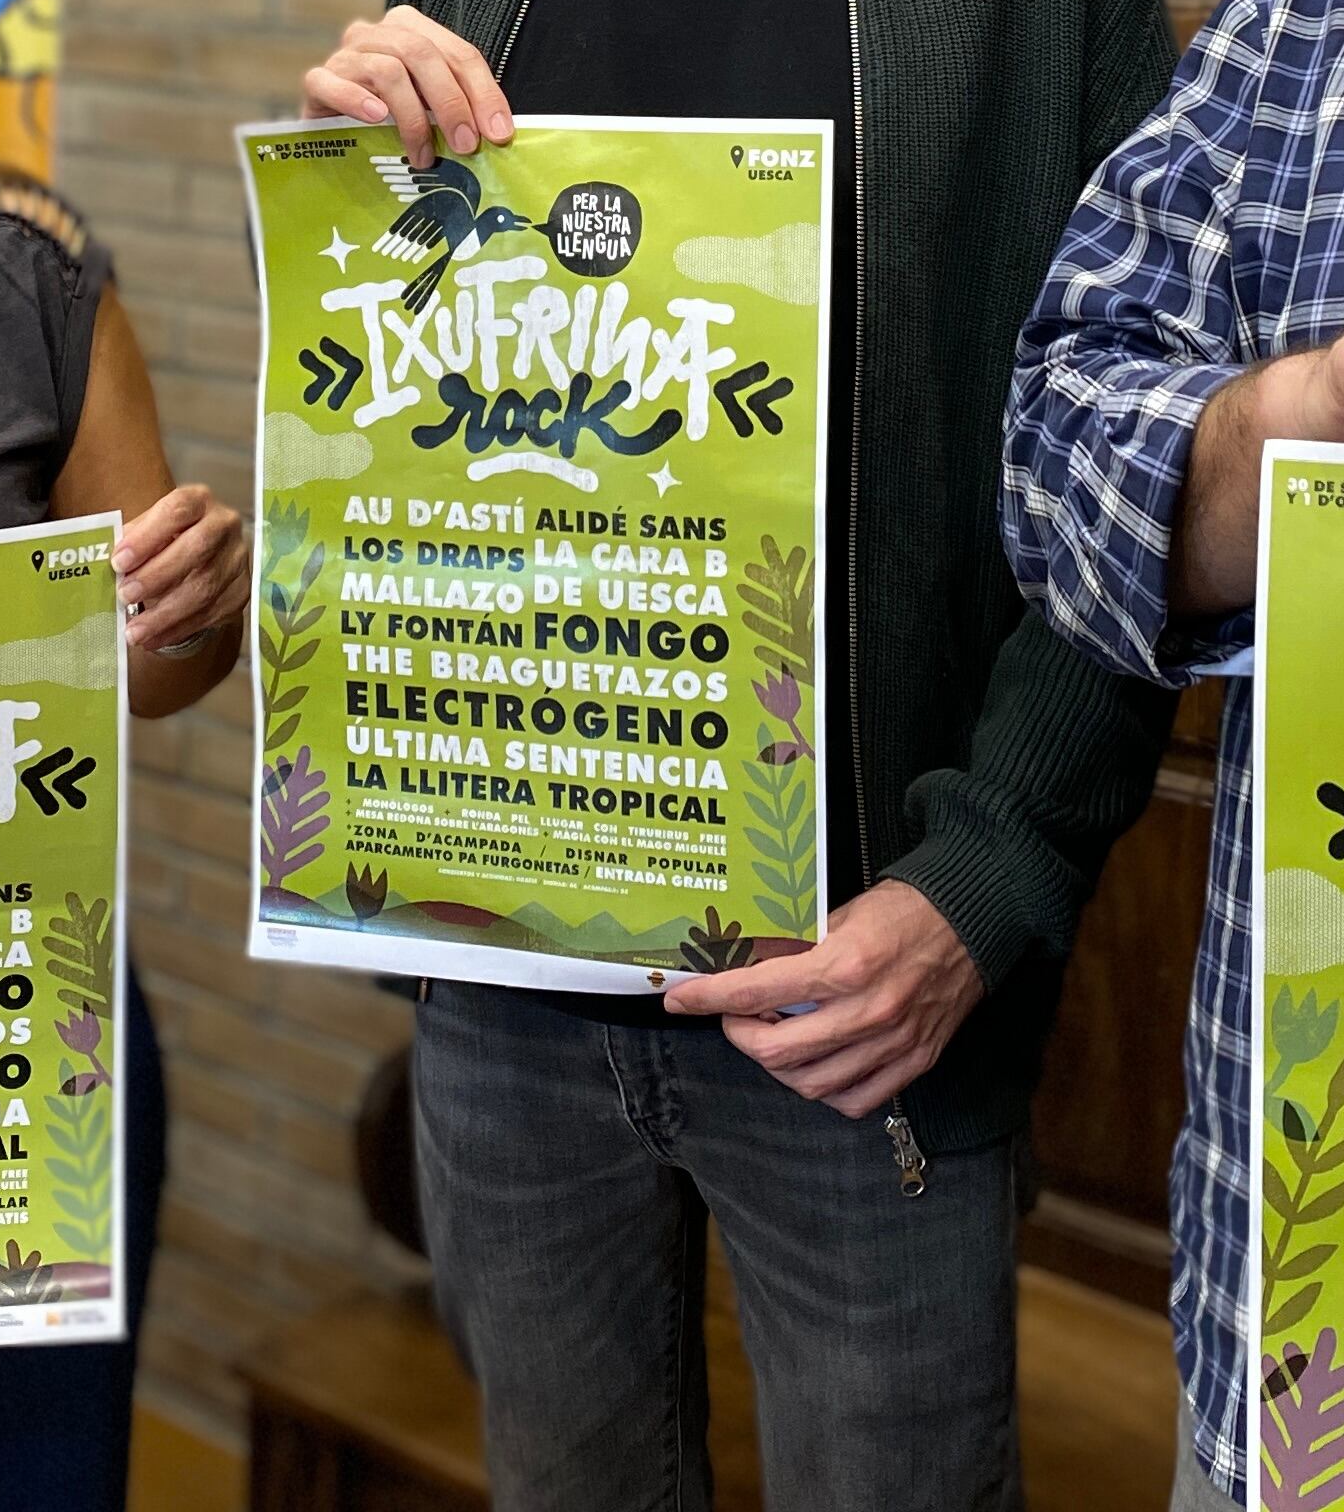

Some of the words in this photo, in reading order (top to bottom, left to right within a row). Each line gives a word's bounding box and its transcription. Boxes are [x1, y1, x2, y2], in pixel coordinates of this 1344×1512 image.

[275, 144, 291, 153] DE
[294, 139, 358, 151] SETIEMBRE
[281, 149, 346, 160] D'OCTUBRE
[748, 149, 816, 168] FONZ
[748, 170, 793, 181] UESCA
[573, 192, 598, 211] PER
[604, 194, 621, 213] LA
[562, 211, 631, 235] NUESTRA
[557, 232, 632, 260] LLENGUA
[1287, 493, 1297, 504] Y
[1288, 478, 1309, 491] 30
[1314, 480, 1335, 492] DE
[344, 496, 392, 524] AU
[408, 499, 524, 533] D'ASTÍ
[536, 506, 626, 536] ALIDÉ
[640, 515, 726, 541] SANS
[48, 542, 110, 569] FONZ
[345, 537, 402, 561] LOS
[417, 542, 525, 572] DRAPS
[535, 539, 578, 569] LA
[591, 543, 689, 577] CARA
[705, 549, 727, 578] B
[48, 566, 90, 581] UESCA
[340, 572, 524, 614] MALLAZO
[534, 575, 583, 607] DE
[598, 580, 728, 617] UESCA
[342, 611, 375, 635] LY
[389, 614, 522, 647] FONTÁN
[535, 612, 729, 663] FONGO
[343, 643, 412, 675] THE
[431, 651, 727, 702] BRAGUETAZOS
[346, 681, 728, 749] ELECTRÓGENO
[347, 717, 490, 767] ÚLTIMA
[505, 741, 728, 790] SENTENCIA
[348, 762, 386, 789] LA
[401, 768, 535, 805] LLITERA
[549, 783, 725, 825] TROPICAL
[345, 840, 453, 863] APARCAMENTO
[458, 852, 477, 865] PA
[482, 854, 579, 876] FURGONETAS
[595, 866, 667, 886] ENTRADA
[671, 875, 728, 893] GRATIS
[416, 831, 522, 854] D'ACAMPADA
[565, 847, 628, 866] DISNAR
[647, 856, 727, 875] POPULAR
[11, 909, 32, 933] B
